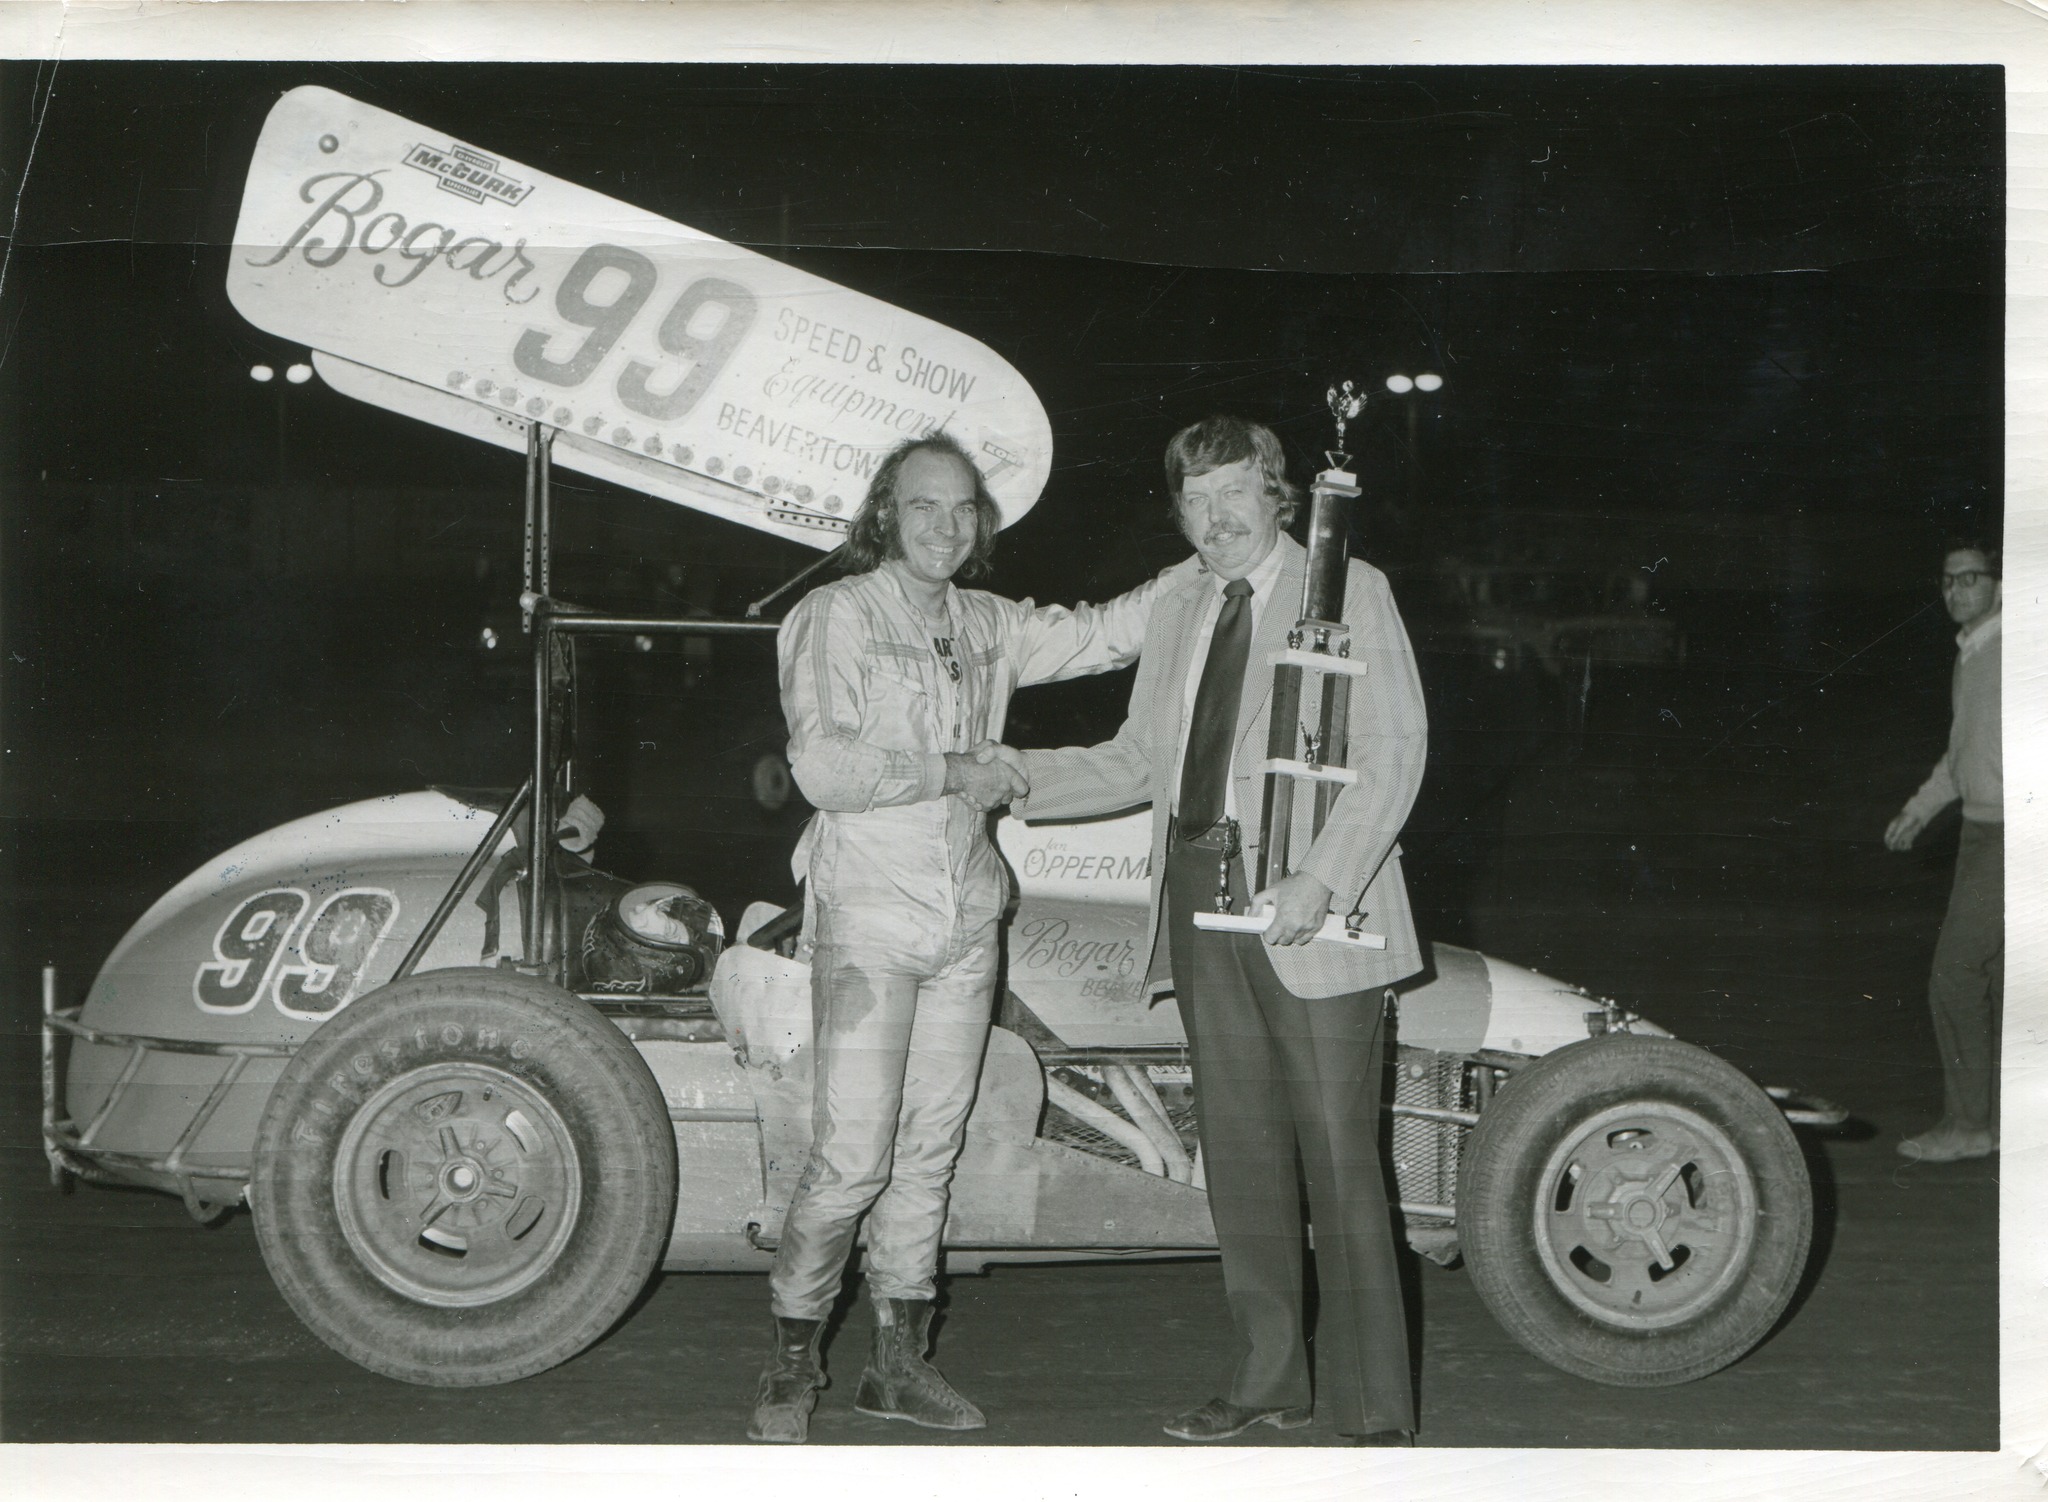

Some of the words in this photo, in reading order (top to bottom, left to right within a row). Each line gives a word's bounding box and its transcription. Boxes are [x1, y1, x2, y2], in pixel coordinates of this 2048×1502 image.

[245, 168, 540, 304] Bogar
[513, 243, 758, 421] 99
[774, 307, 862, 364] SPEED
[866, 344, 887, 374] &
[896, 347, 977, 403] SHOW
[763, 356, 959, 438] Equipment
[1023, 848, 1151, 880] OPPERM
[192, 887, 400, 1021] 99
[1009, 917, 1136, 977] Bogar
